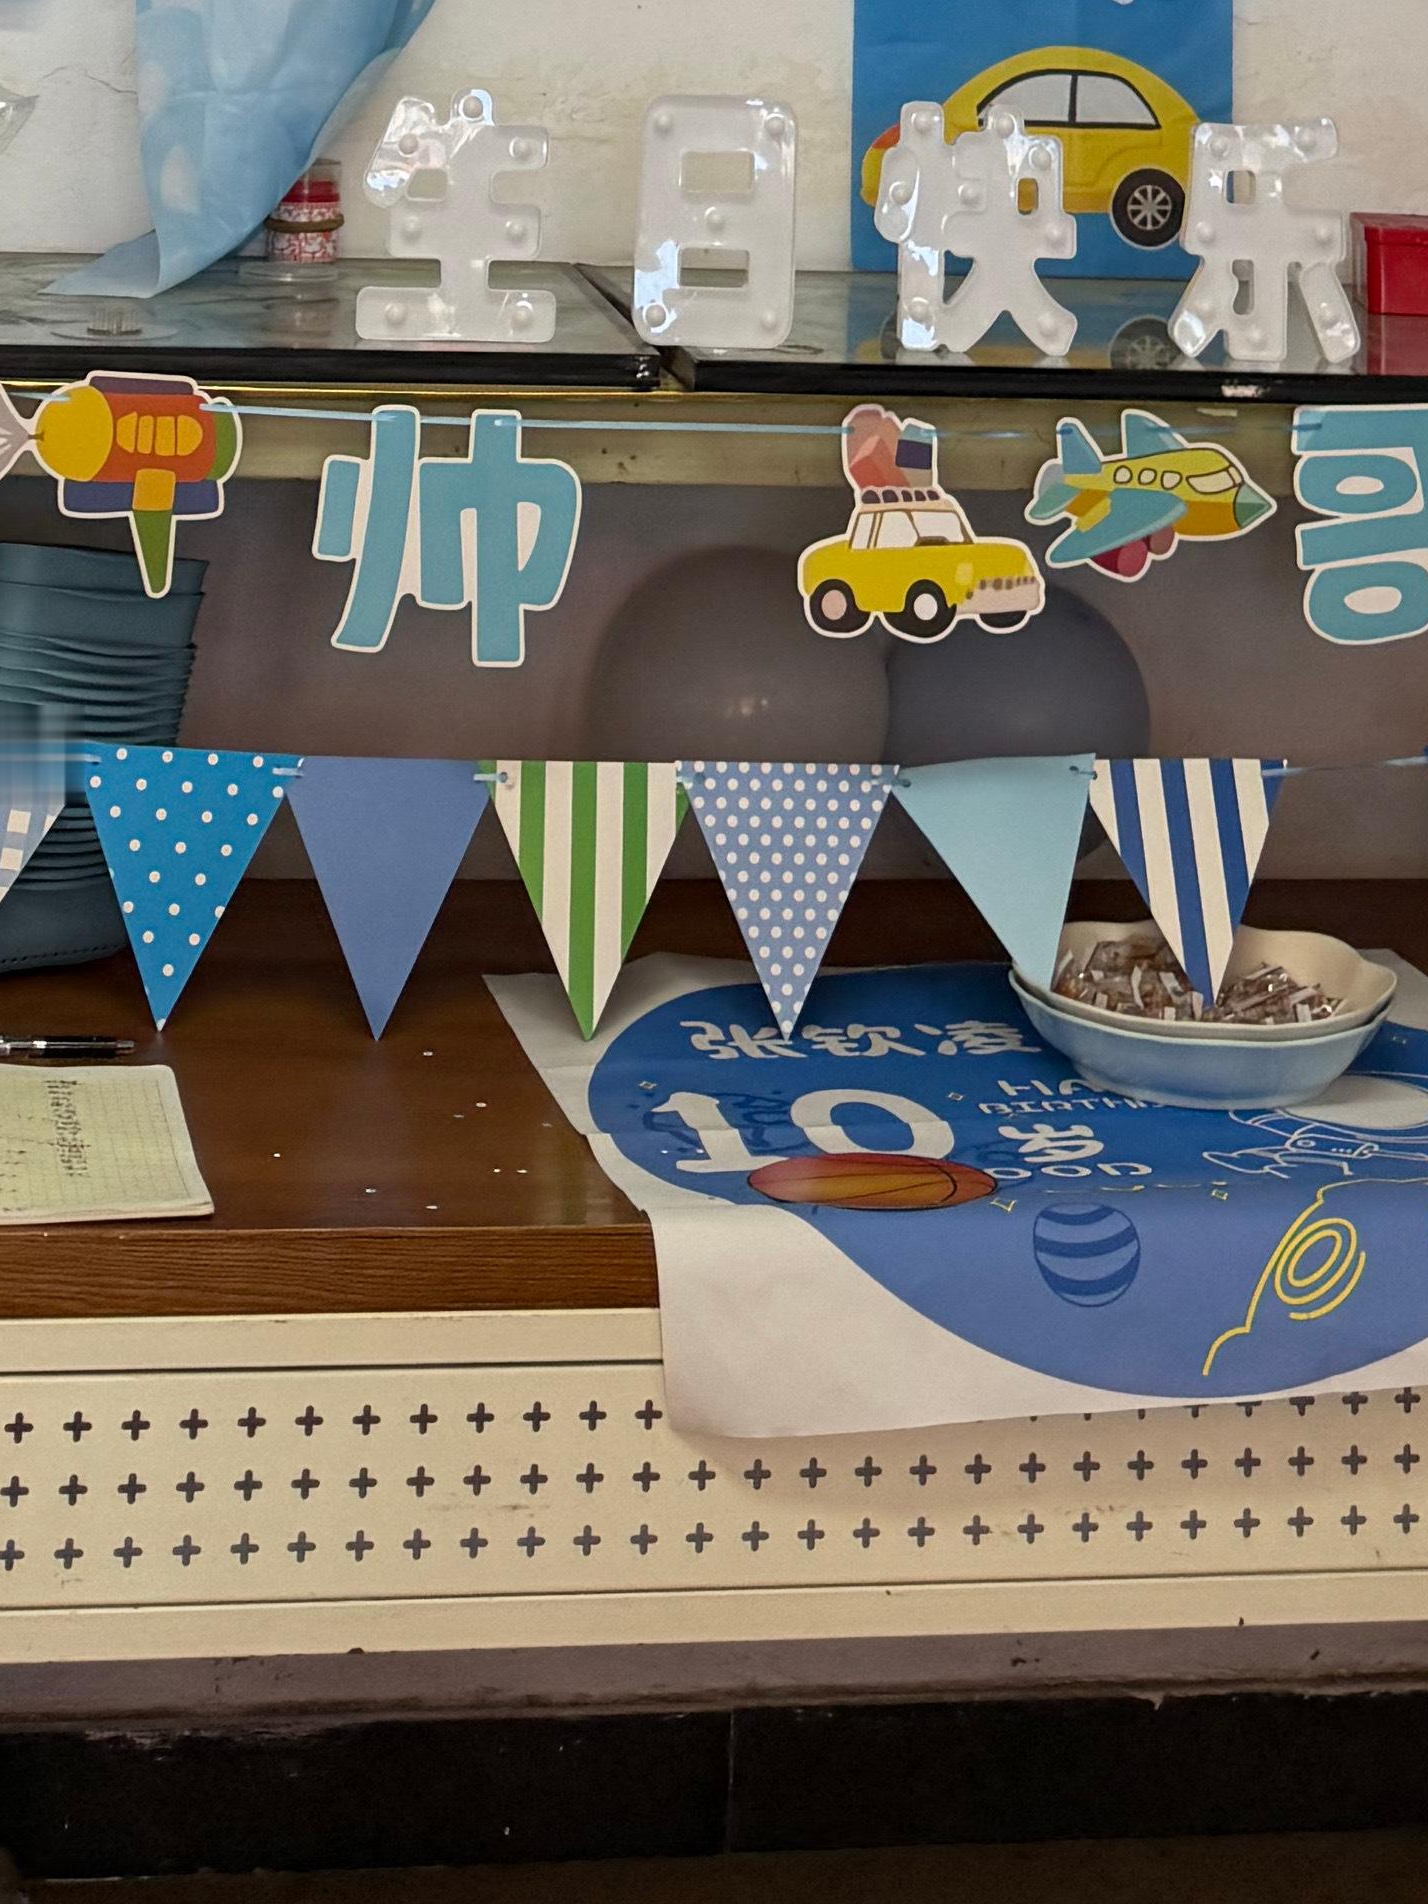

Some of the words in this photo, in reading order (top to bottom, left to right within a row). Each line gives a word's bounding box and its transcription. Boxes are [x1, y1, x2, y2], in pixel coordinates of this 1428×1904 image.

[355, 87, 1362, 363] 生日快乐
[315, 407, 579, 662] 帅
[647, 1088, 955, 1174] 10
[997, 1123, 1105, 1164] 岁
[978, 1097, 1166, 1116] BIRTH
